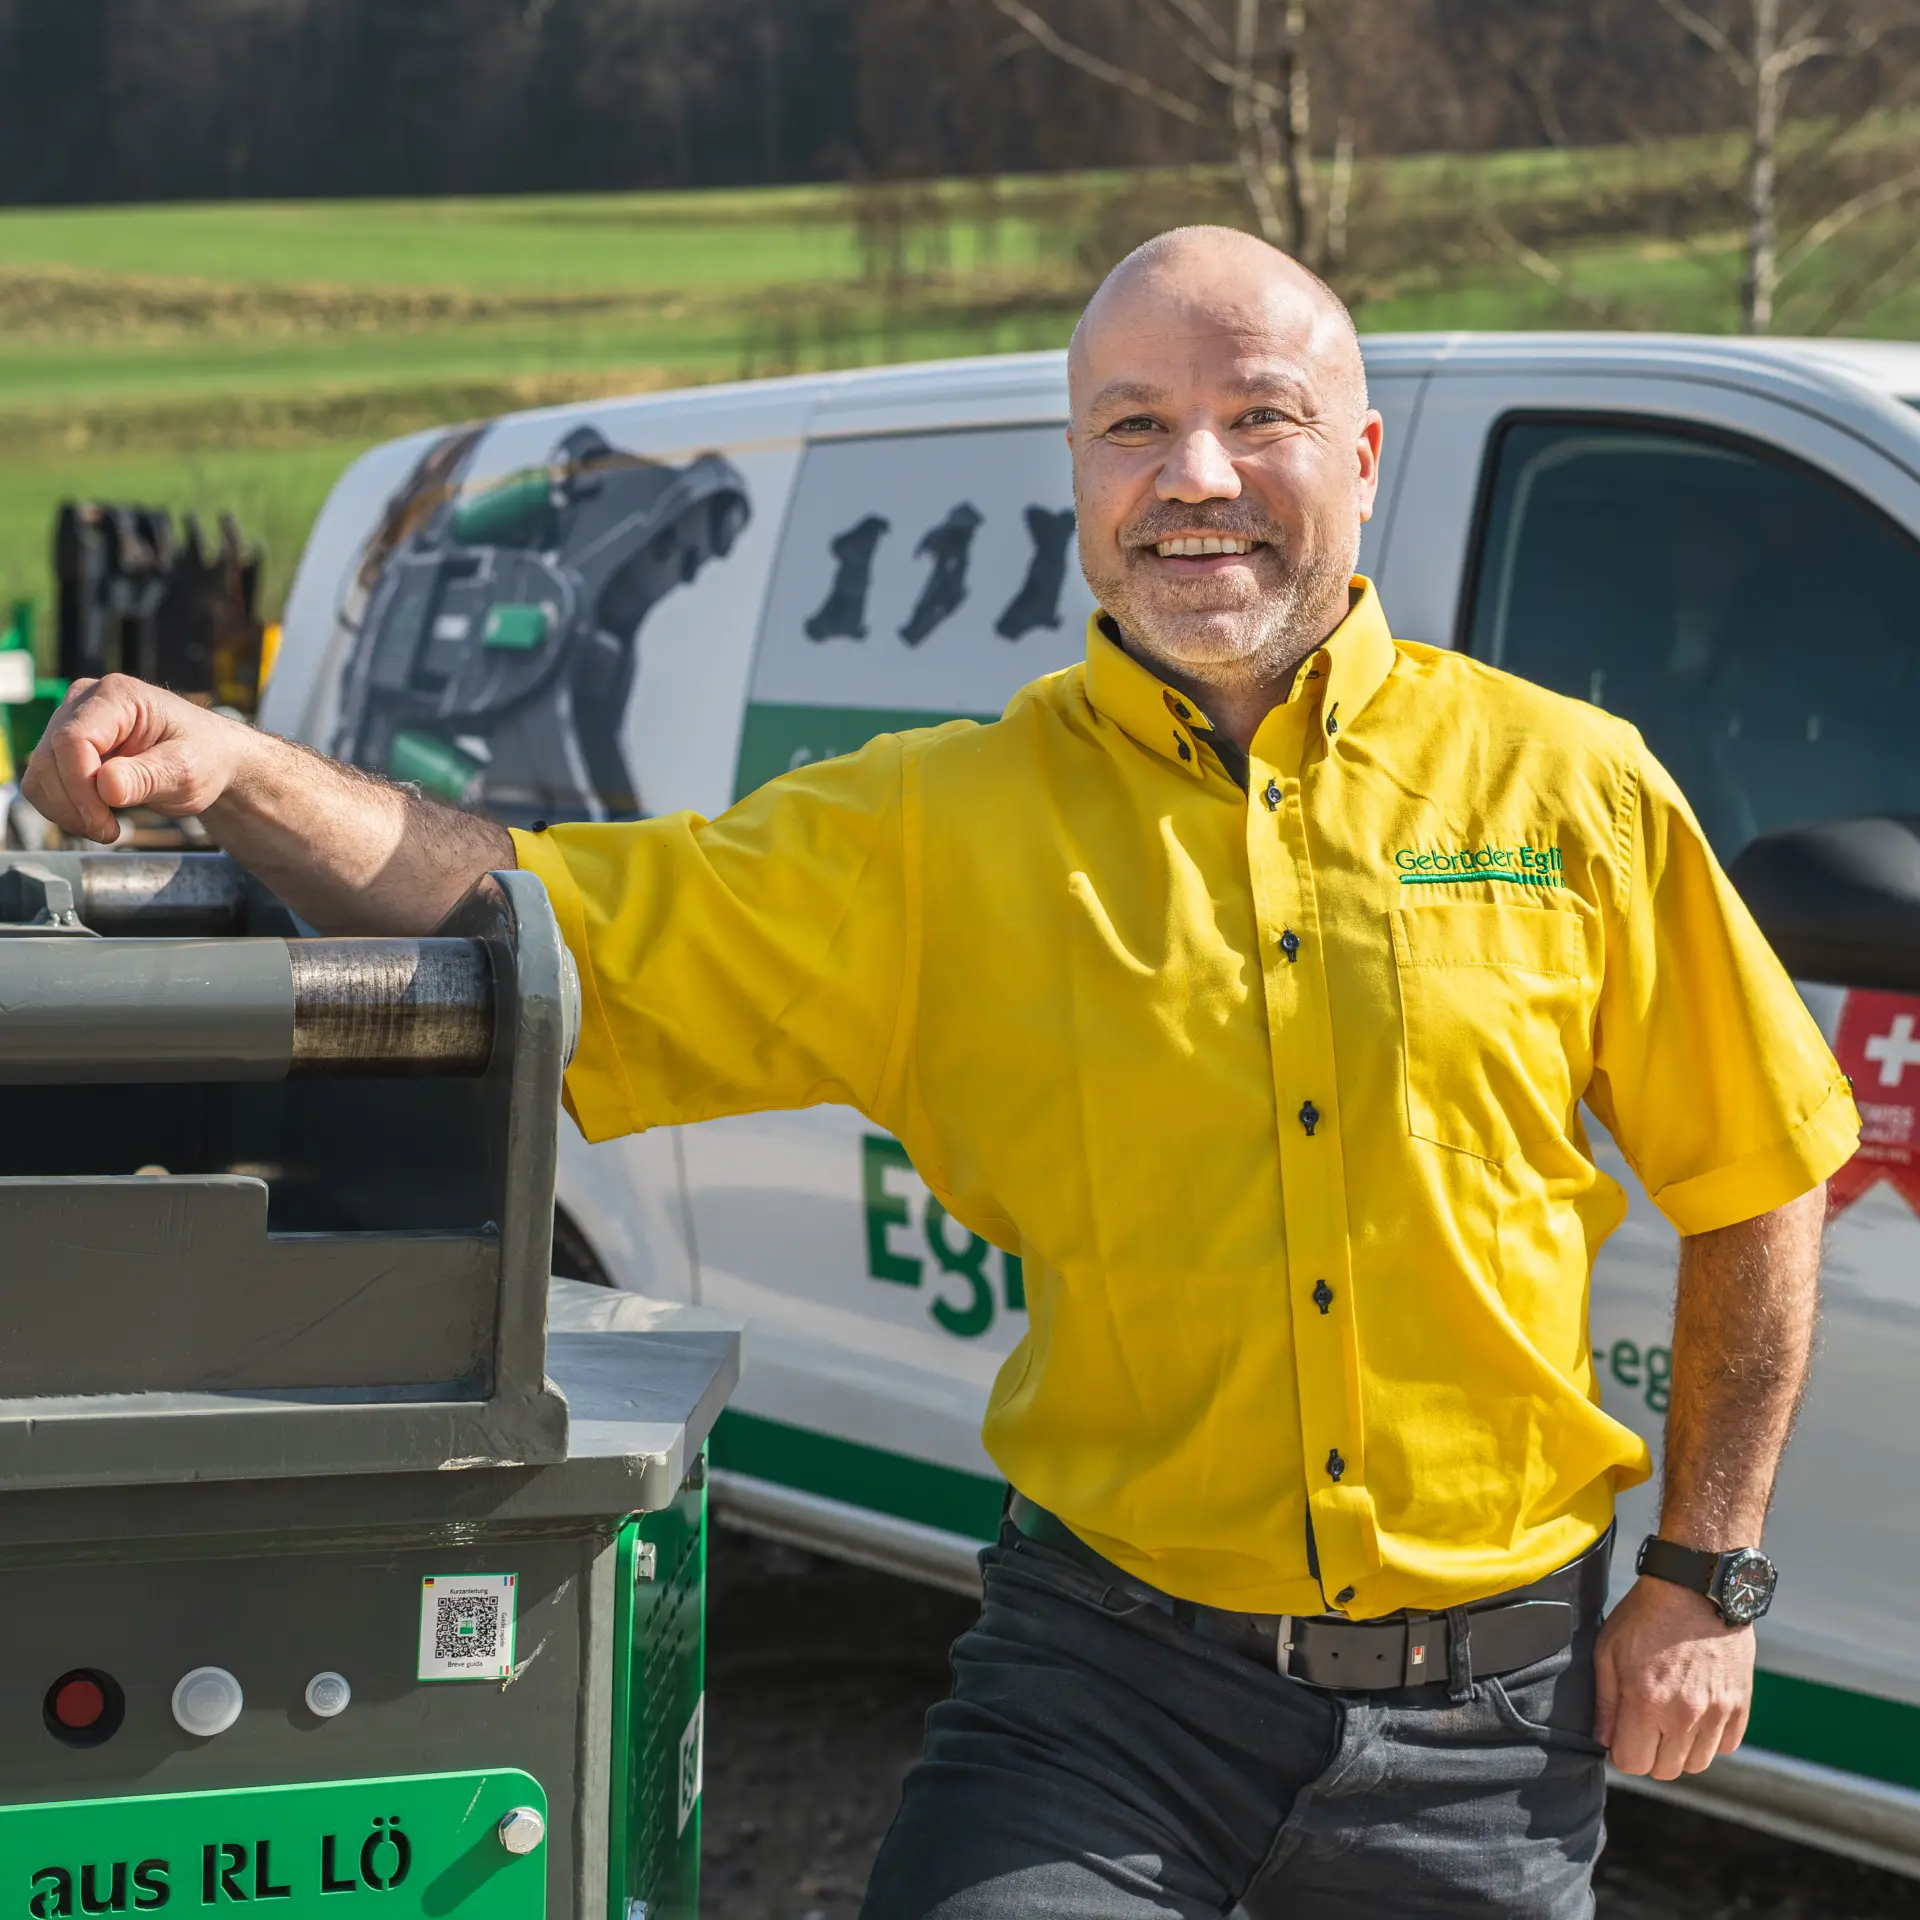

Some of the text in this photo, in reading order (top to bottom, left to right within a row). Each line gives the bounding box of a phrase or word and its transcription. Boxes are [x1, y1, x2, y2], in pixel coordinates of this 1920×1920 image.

[1396, 844, 1563, 874] Gebrüder Egli
[466, 1660, 483, 1669] guida
[29, 1815, 412, 1920] aus RL LÖ
